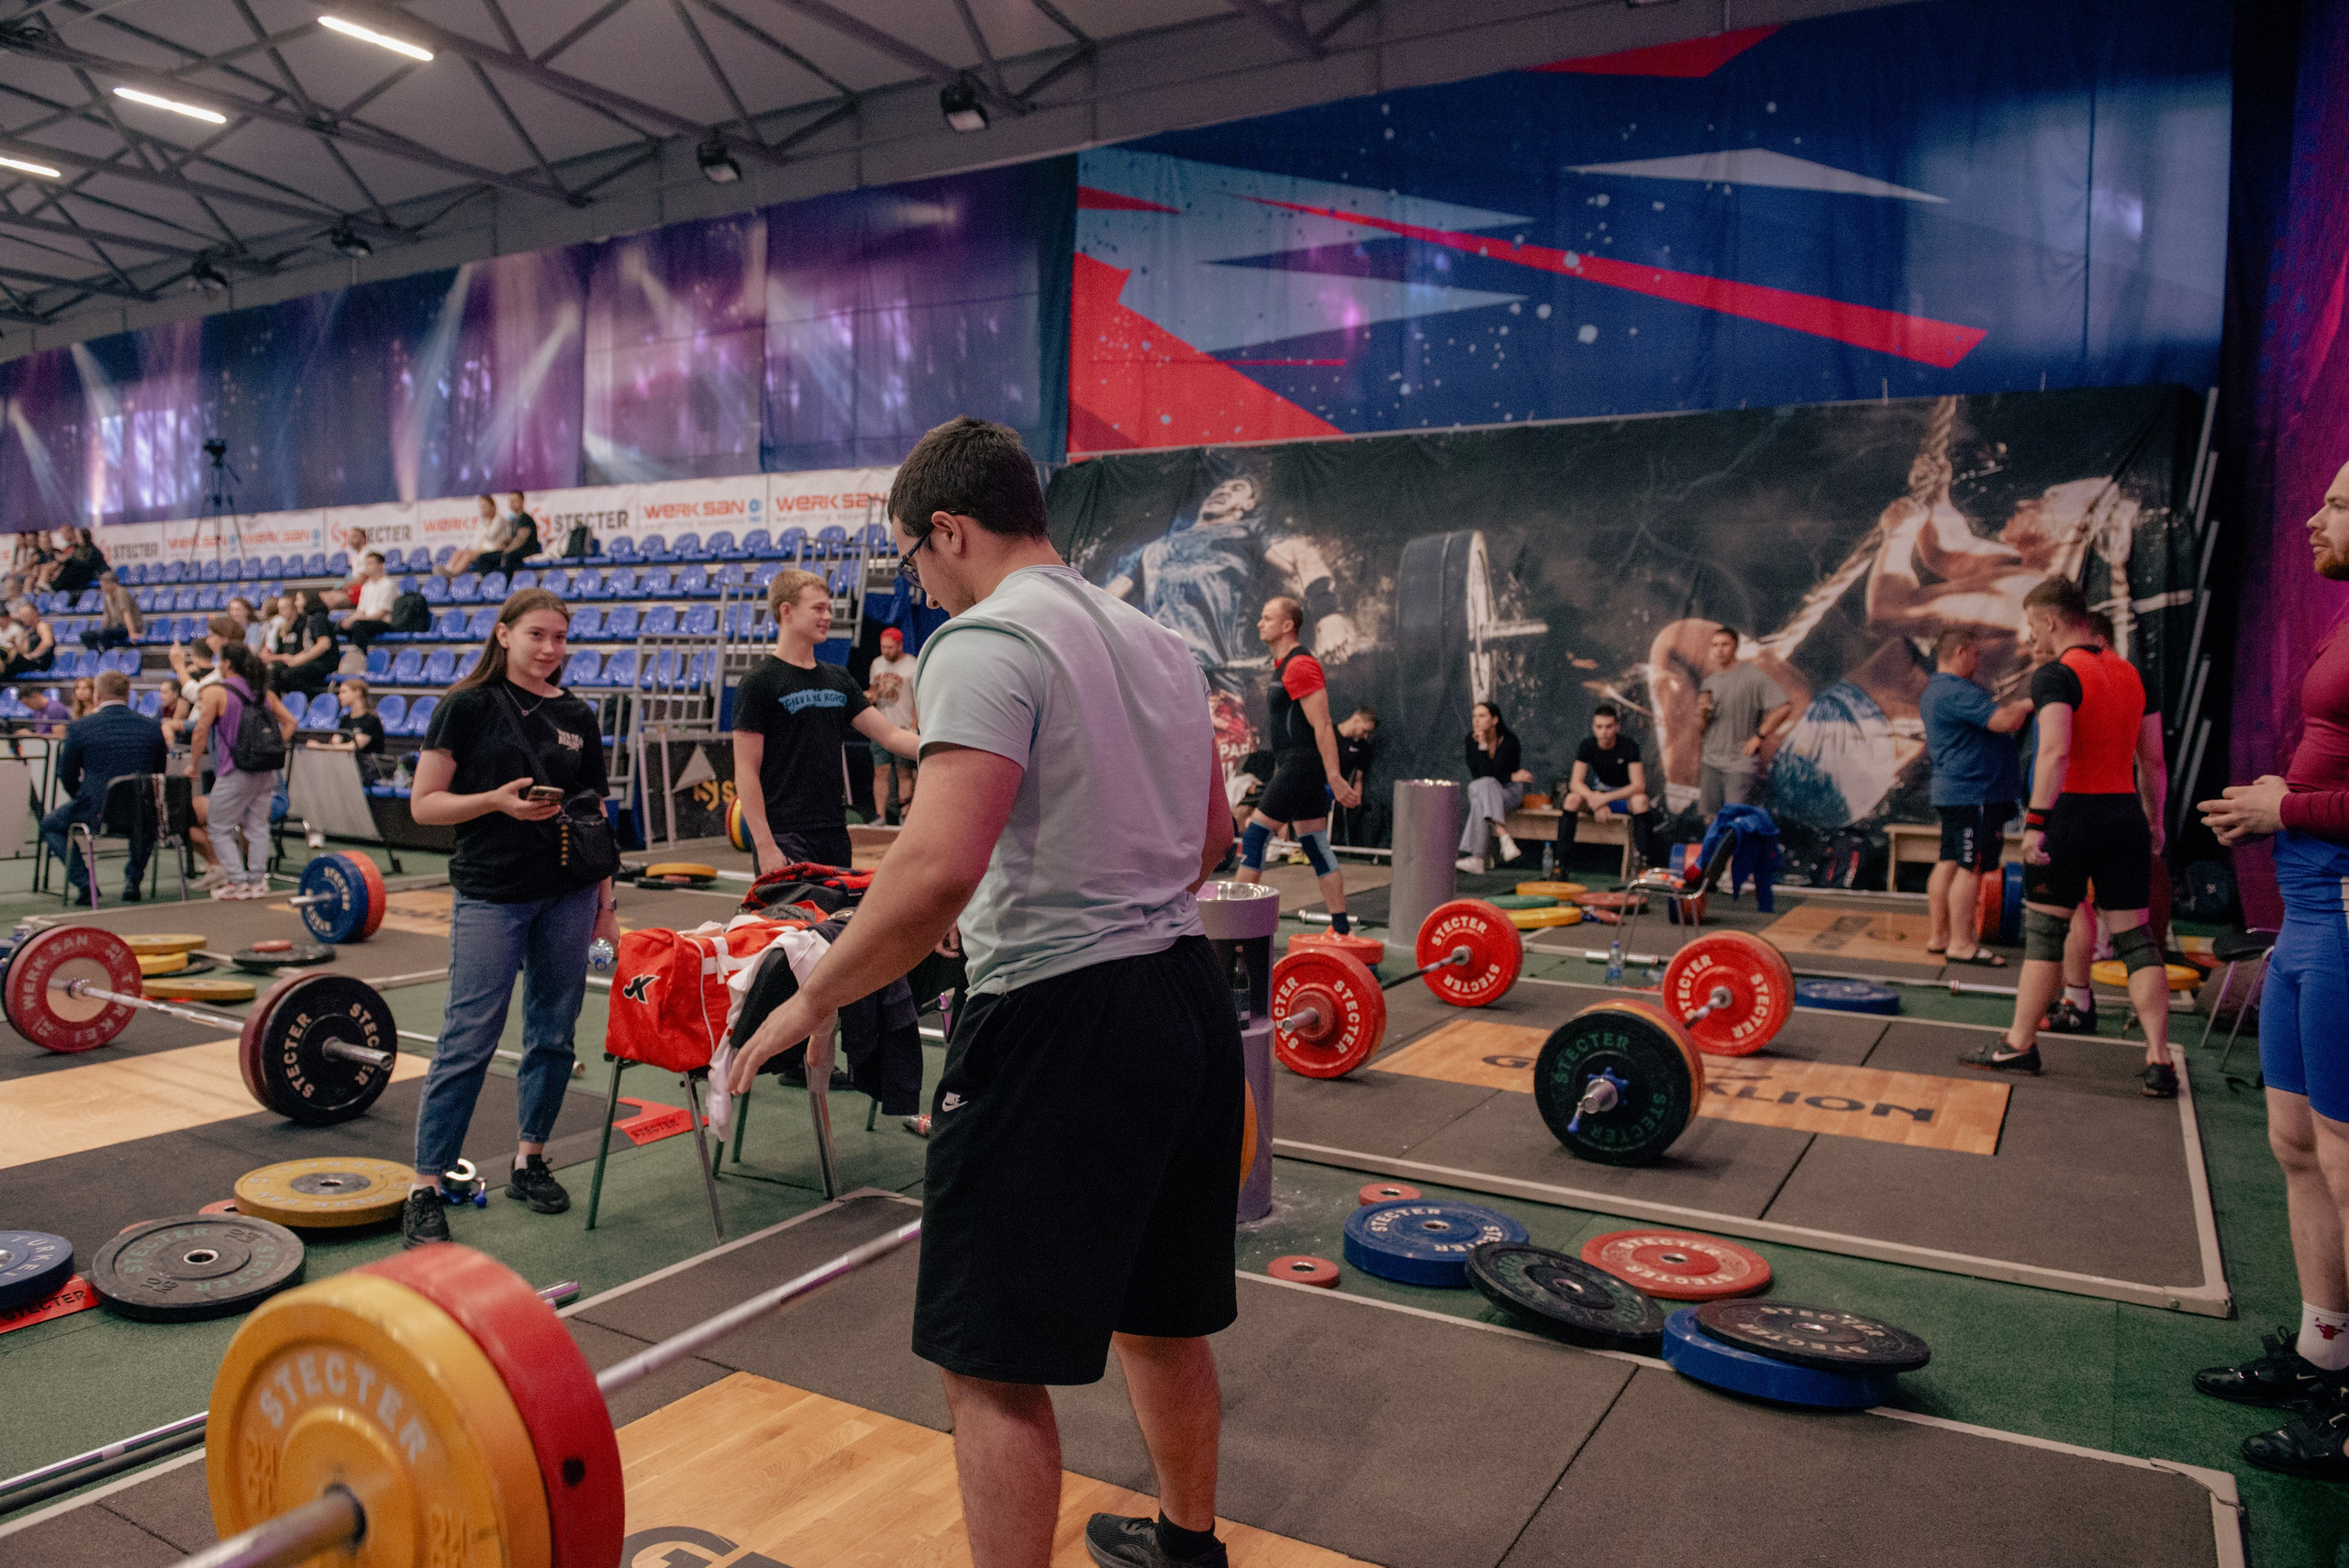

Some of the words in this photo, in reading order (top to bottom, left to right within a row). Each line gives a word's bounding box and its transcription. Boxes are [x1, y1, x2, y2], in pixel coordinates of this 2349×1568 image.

[366, 525, 411, 543] ECTER
[1431, 916, 1487, 946] STECTER
[23, 956, 47, 1010] WERK
[50, 935, 89, 955] SAN
[1443, 963, 1500, 993] STECTER
[1677, 954, 1713, 1020] STECTER
[1275, 976, 1299, 1050] STECTER
[1333, 980, 1360, 1054] STECTER
[1731, 973, 1770, 1039] STECTER
[284, 1012, 316, 1098] STECTER
[350, 1002, 381, 1086] STECER
[1553, 1032, 1630, 1084] STECTER
[1590, 1093, 1668, 1143] STECTER
[1371, 1207, 1442, 1233] STECTER
[3, 1236, 56, 1277] TURKEI
[123, 1227, 210, 1274] STECTER
[194, 1244, 276, 1293] STECTER
[1618, 1238, 1721, 1256] STECTER
[1624, 1265, 1734, 1285] STECTER
[1736, 1323, 1869, 1354] STECTER
[1759, 1307, 1886, 1337] STECTER
[260, 1353, 428, 1464] STECTER
